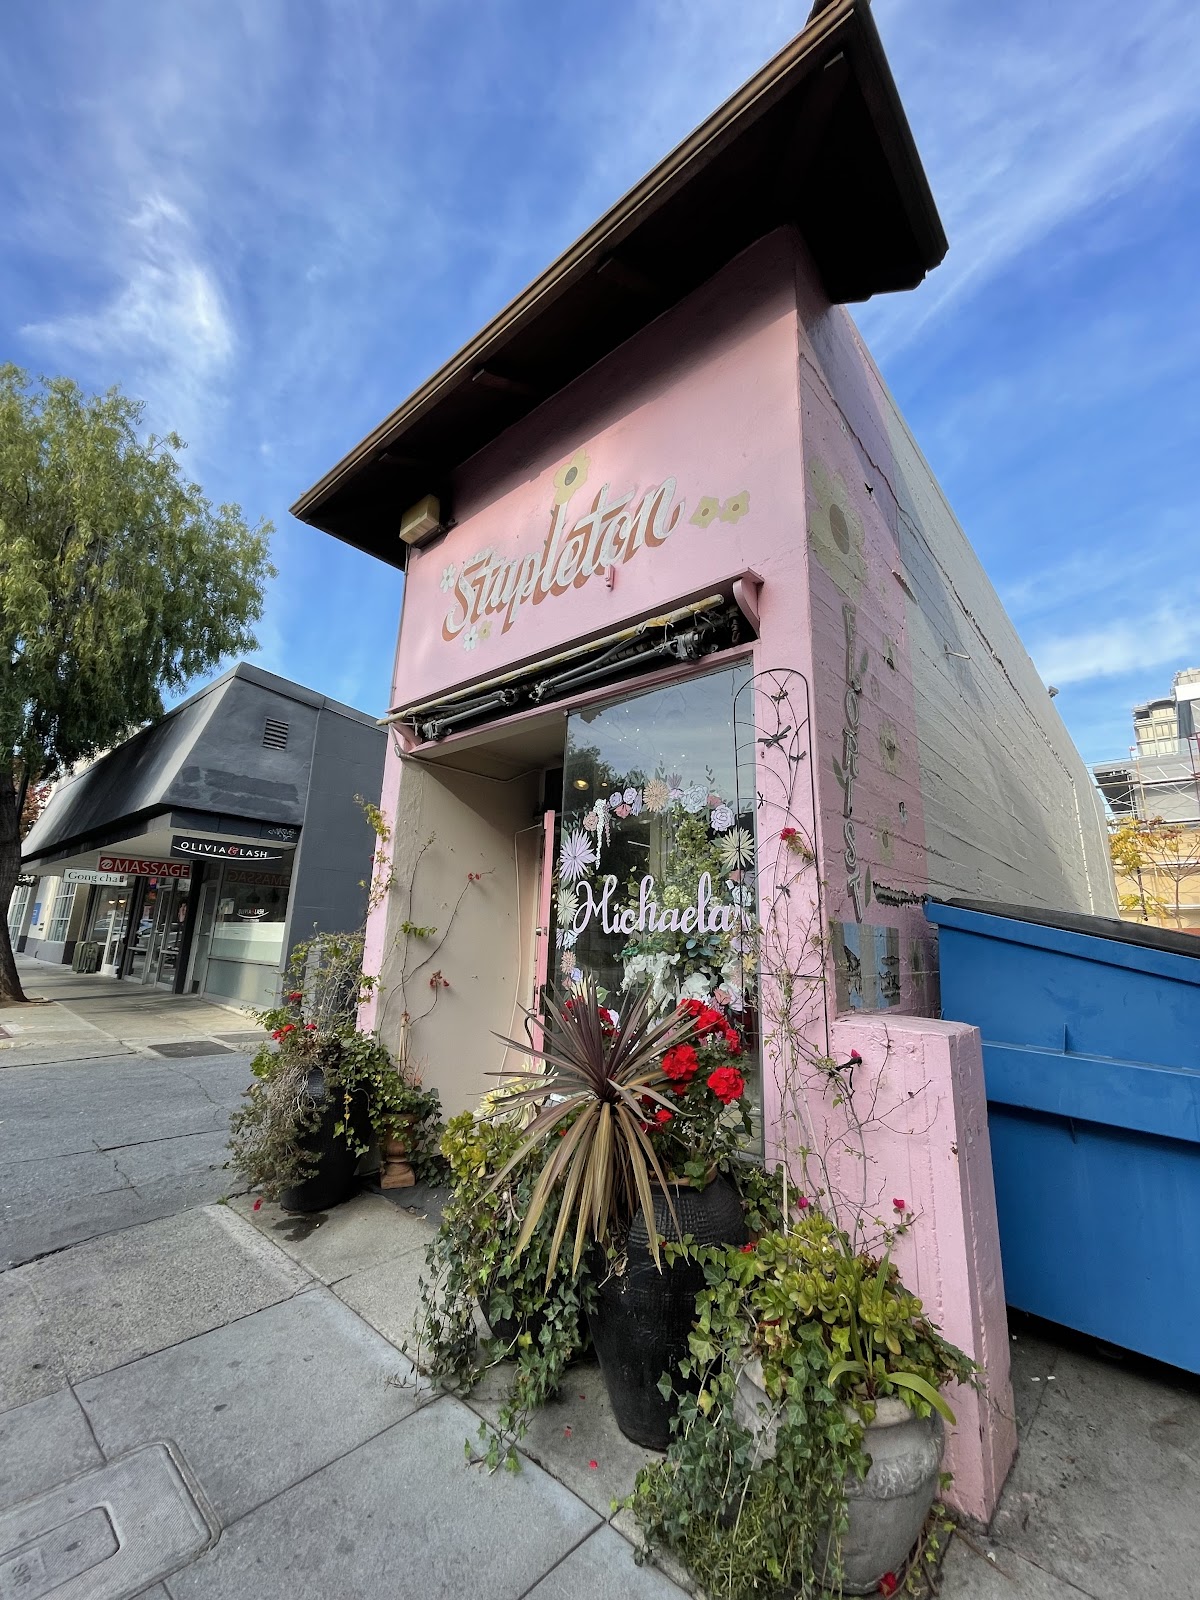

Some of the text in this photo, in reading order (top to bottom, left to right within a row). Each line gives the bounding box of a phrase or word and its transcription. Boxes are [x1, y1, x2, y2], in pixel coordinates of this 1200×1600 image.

[441, 476, 686, 642] Stapleton
[68, 871, 97, 883] Gong
[99, 874, 118, 883] cha
[113, 859, 190, 877] MASSAGE
